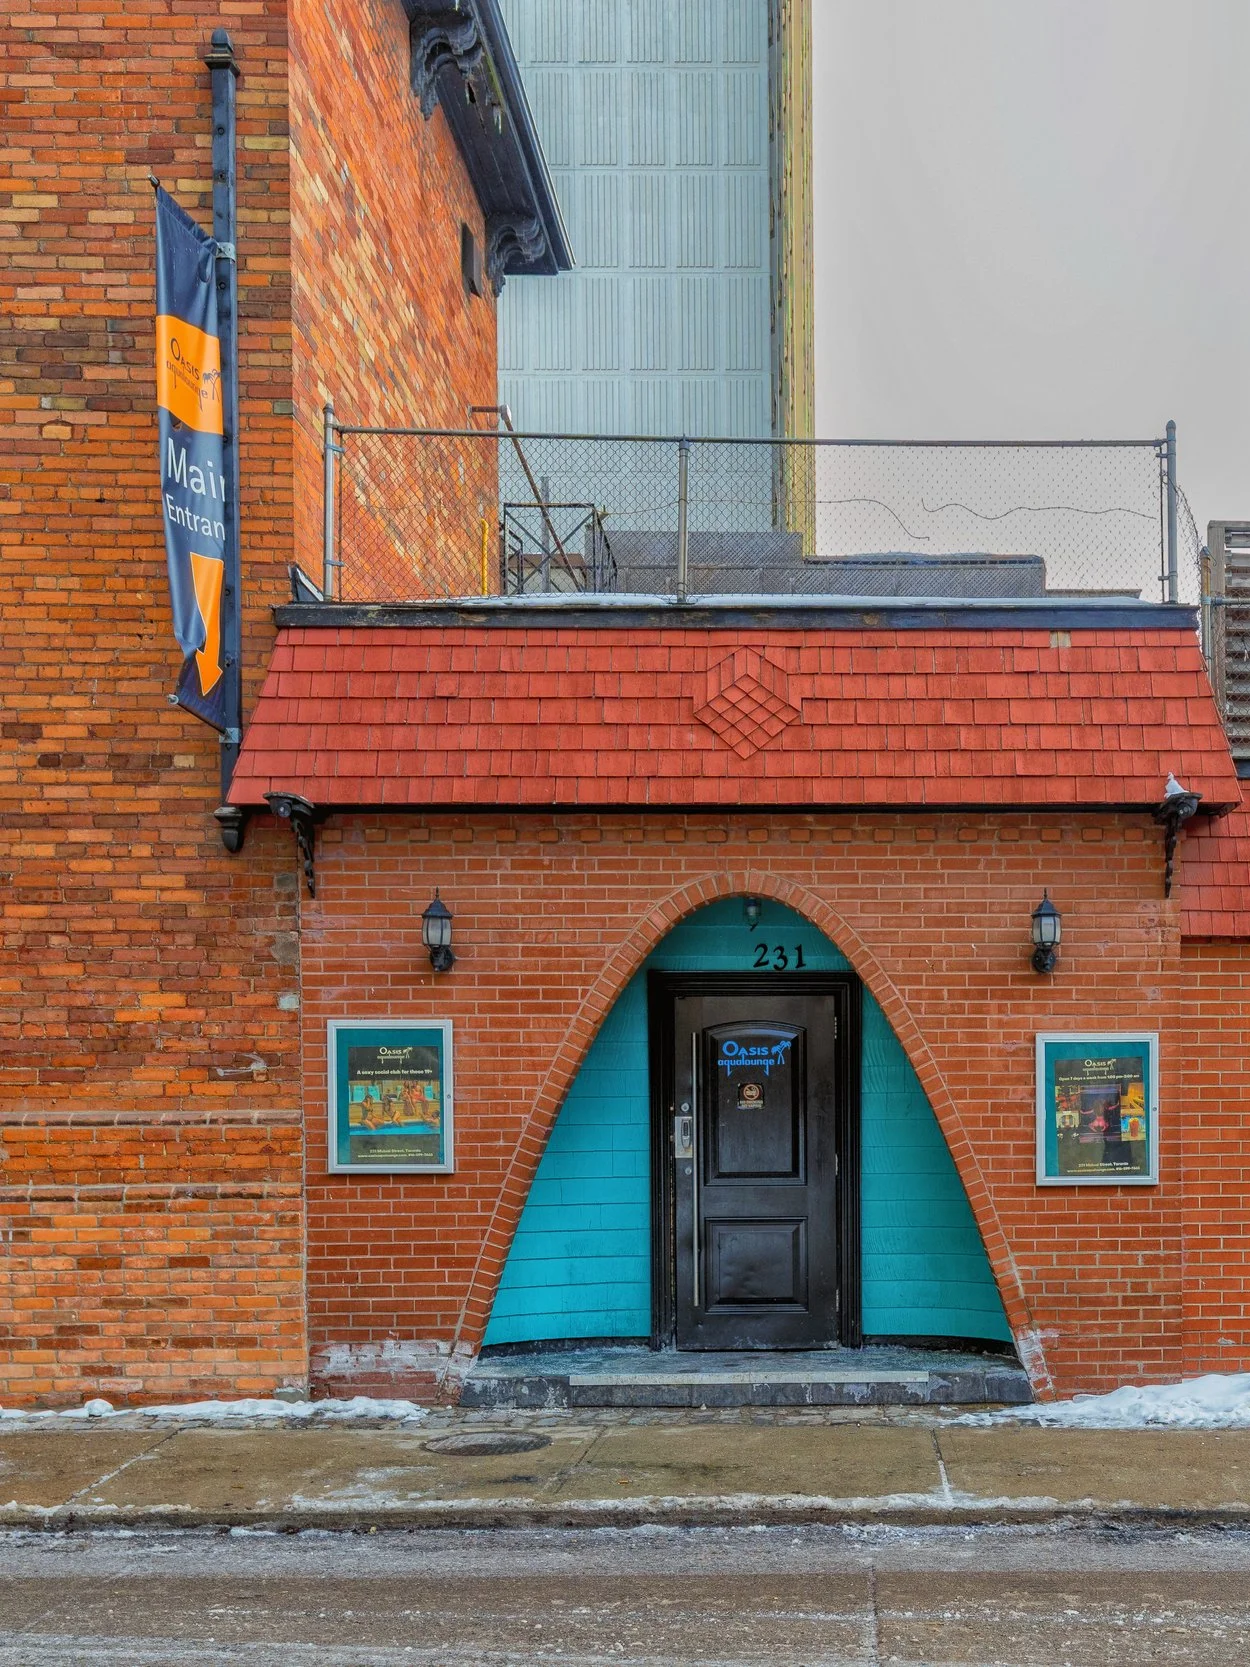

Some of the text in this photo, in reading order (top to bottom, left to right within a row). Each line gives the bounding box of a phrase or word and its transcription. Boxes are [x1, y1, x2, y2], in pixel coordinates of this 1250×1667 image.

[753, 944, 806, 971] 231
[722, 1041, 769, 1057] OASIS
[718, 1055, 775, 1077] aqualounge
